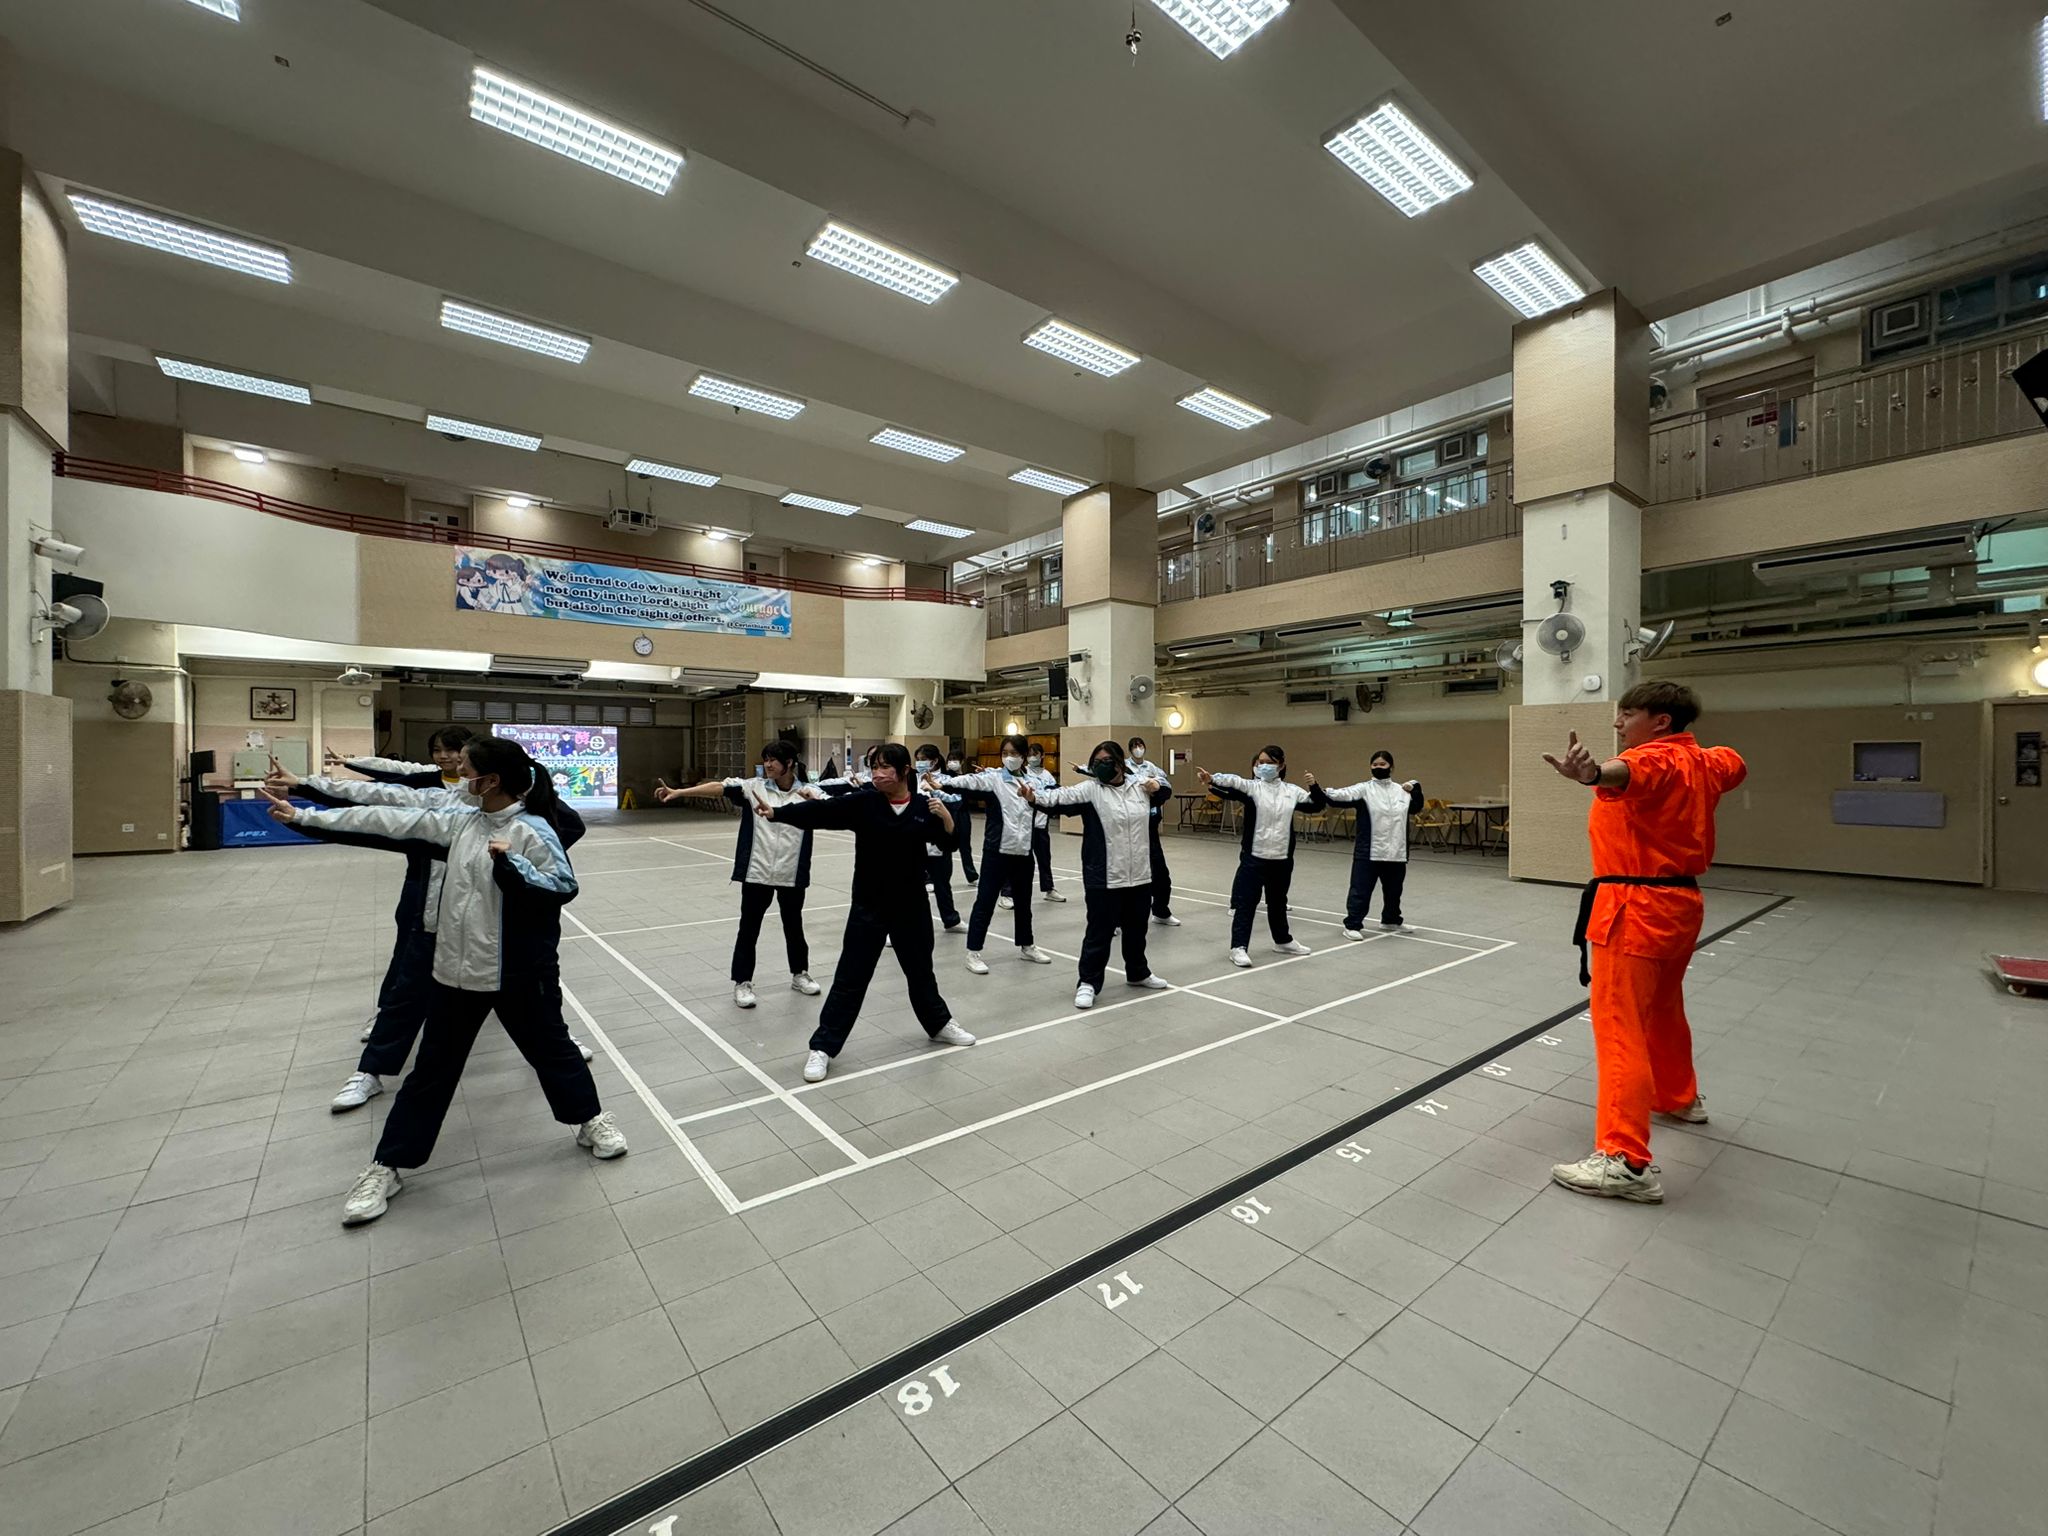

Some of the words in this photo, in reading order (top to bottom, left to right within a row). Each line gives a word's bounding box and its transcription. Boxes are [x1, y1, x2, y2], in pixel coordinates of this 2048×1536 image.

[546, 570, 567, 581] We
[570, 573, 612, 586] intend
[615, 580, 627, 588] to
[630, 581, 645, 590] do
[648, 584, 679, 594] what
[682, 586, 691, 595] is
[694, 590, 721, 599] right
[546, 586, 569, 595] not
[572, 589, 600, 599] only
[603, 591, 616, 600] in
[619, 593, 639, 602] the
[642, 595, 679, 606] Lord's
[682, 600, 709, 610] sight
[546, 598, 569, 608] but
[572, 602, 598, 611] also
[601, 604, 614, 613] in
[617, 606, 637, 615] the
[640, 608, 669, 619] sight
[672, 612, 683, 620] of
[686, 613, 725, 623] others.
[1536, 1035, 1563, 1046] 12
[1482, 1062, 1512, 1077] 13
[1414, 1098, 1449, 1116] 14
[1335, 1141, 1372, 1163] 15
[1230, 1196, 1272, 1225] 16
[1096, 1270, 1144, 1310] 17
[896, 1364, 961, 1416] 18
